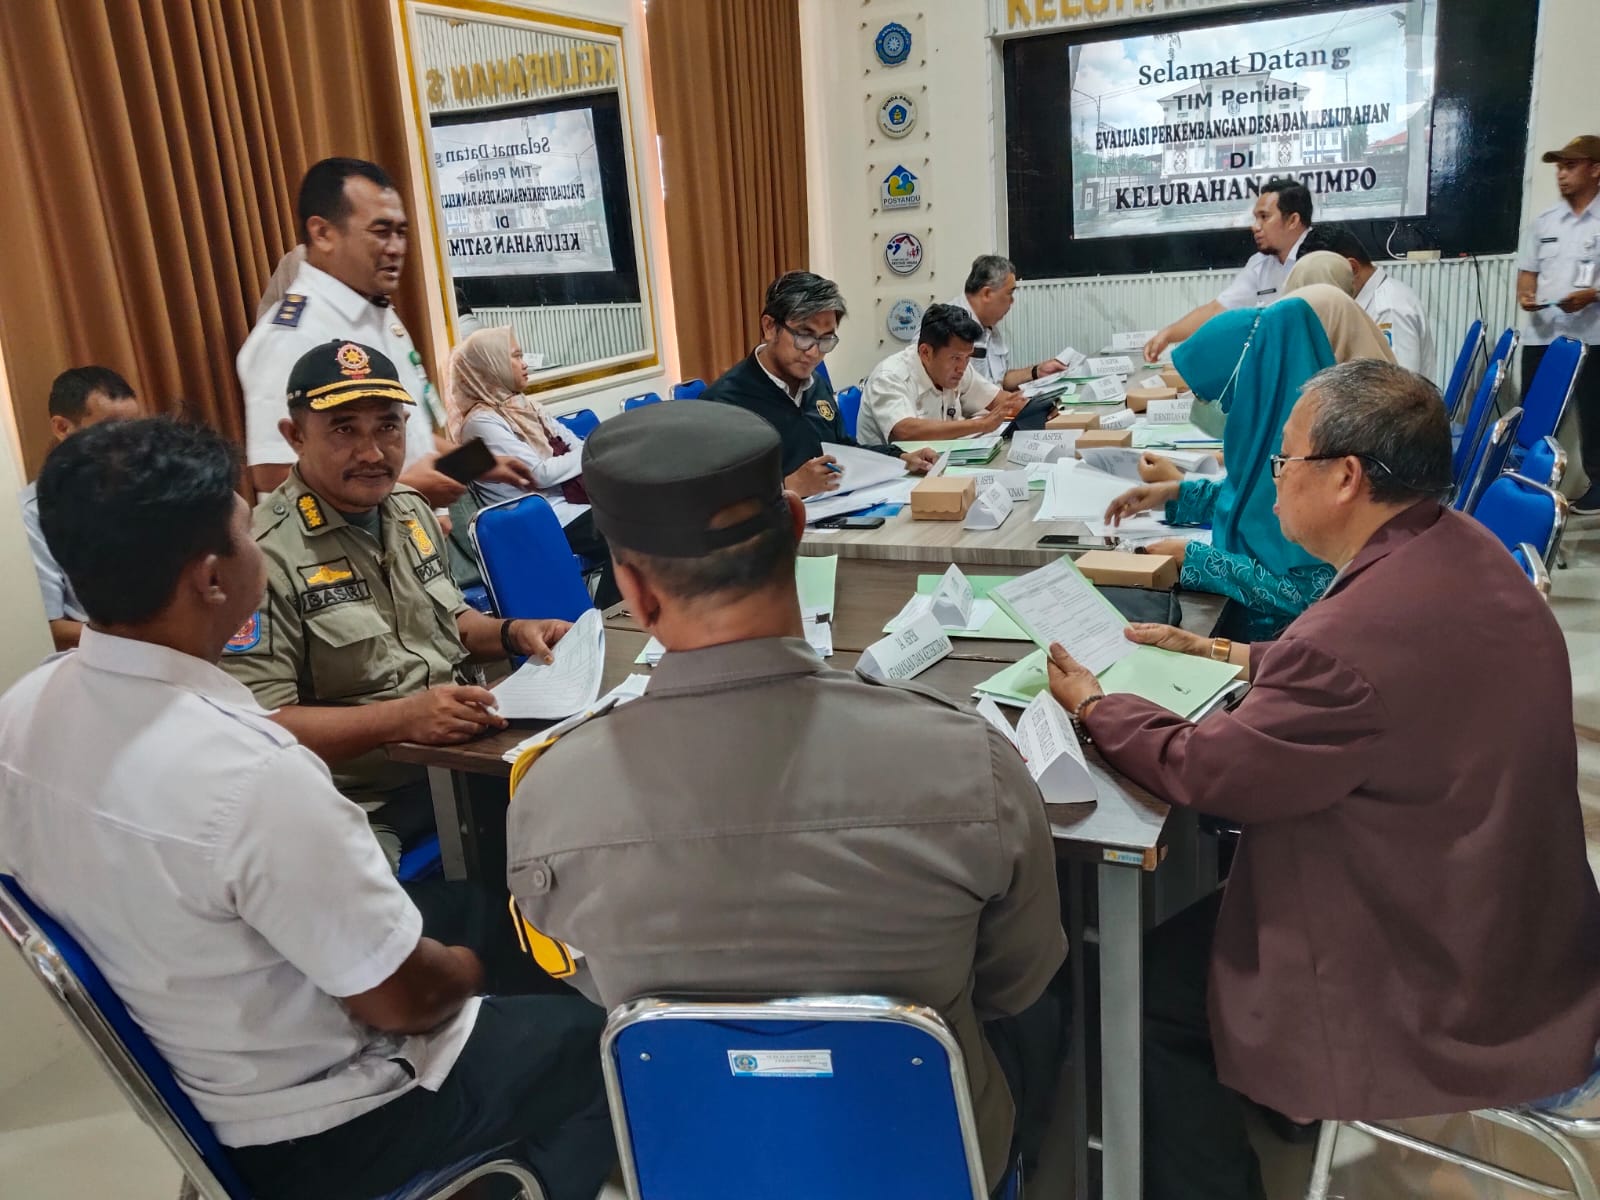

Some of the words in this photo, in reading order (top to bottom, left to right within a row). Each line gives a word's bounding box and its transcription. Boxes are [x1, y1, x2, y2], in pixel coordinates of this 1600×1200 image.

[1138, 55, 1241, 86] Selamat
[1173, 92, 1213, 111] TIM
[1222, 82, 1298, 106] Penilai
[1095, 125, 1150, 150] EVALUASI
[1151, 115, 1247, 144] PERKEMBANGAN
[1249, 112, 1280, 135] DESA
[1282, 109, 1309, 132] DAN
[1230, 150, 1254, 169] DI
[883, 194, 921, 204] POSYANDU
[1115, 175, 1262, 210] KELURAHAN
[1269, 166, 1377, 194] TIMPO
[307, 582, 363, 608] BASRI
